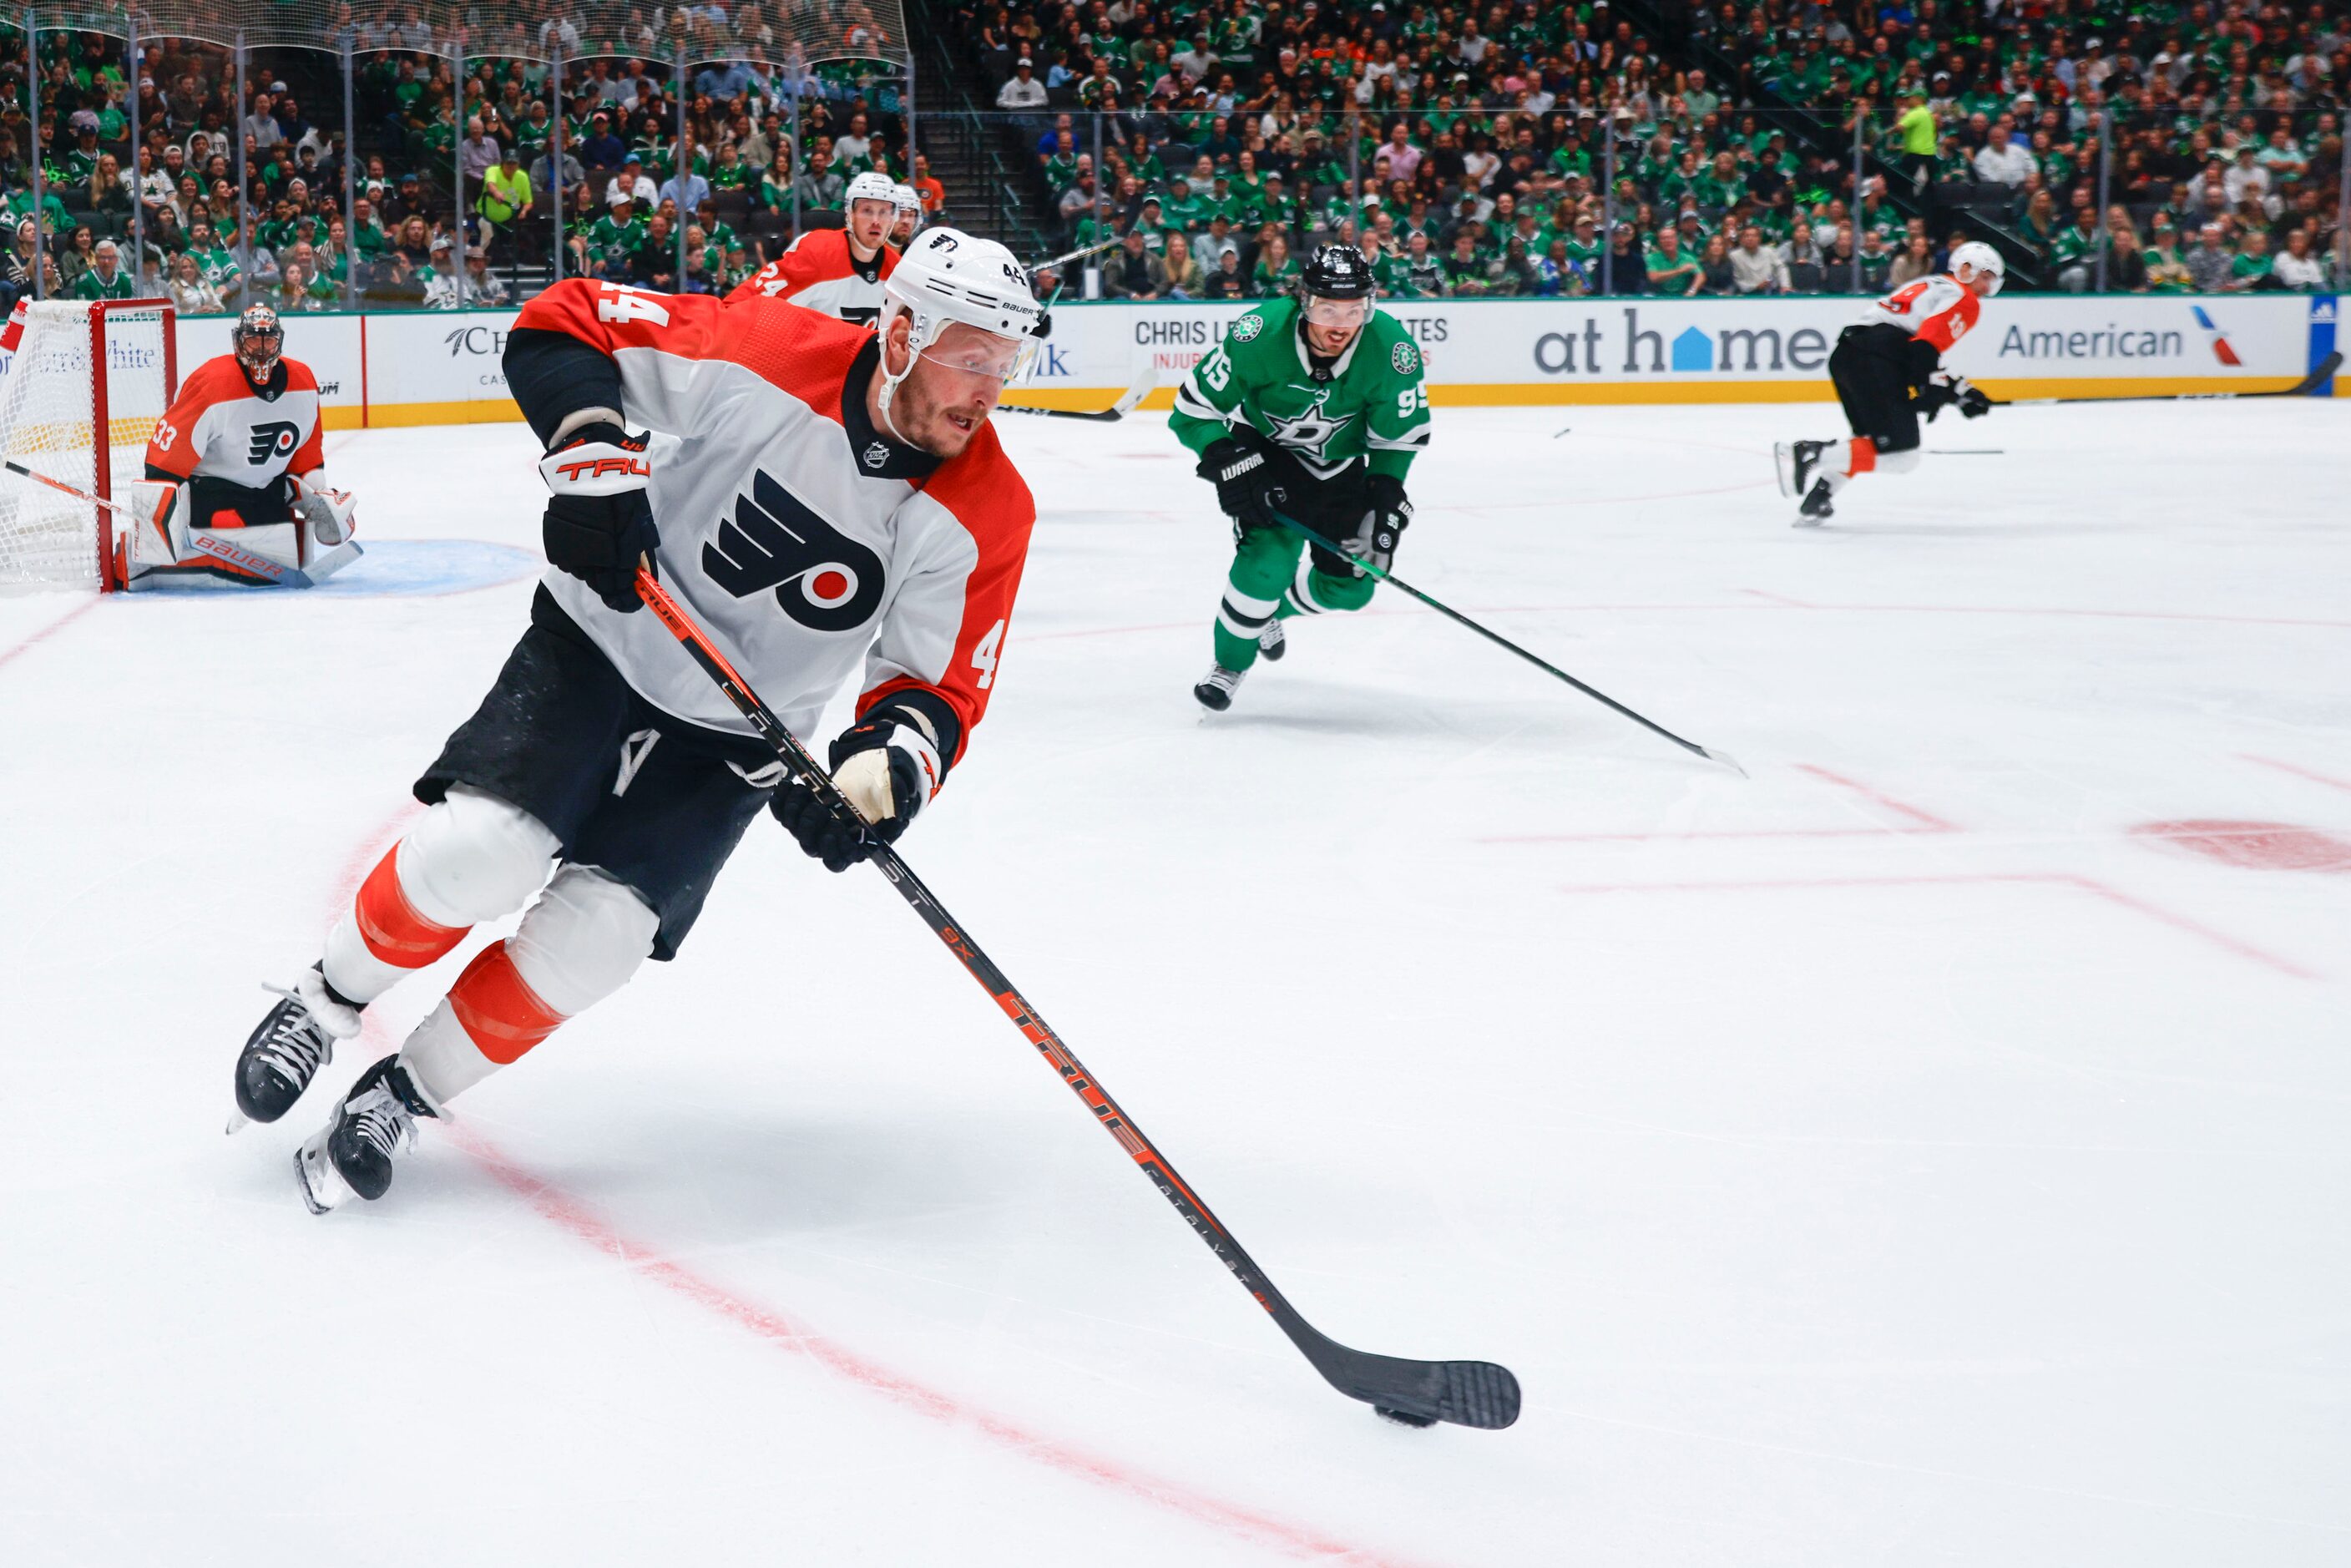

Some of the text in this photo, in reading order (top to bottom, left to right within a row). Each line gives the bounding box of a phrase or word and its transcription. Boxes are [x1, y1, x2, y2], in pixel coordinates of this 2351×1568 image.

[755, 262, 788, 297] 24
[1003, 263, 1027, 287] 44
[1135, 321, 1206, 345] CHRIS
[1398, 318, 1449, 342] TES
[1534, 318, 1601, 374] at
[1998, 323, 2184, 358] American
[254, 364, 268, 381] 33
[1153, 352, 1208, 370] INJUR
[152, 419, 178, 453] 33
[555, 458, 650, 481] TRU
[970, 619, 1005, 690] 4
[1009, 998, 1148, 1156] TRUE
